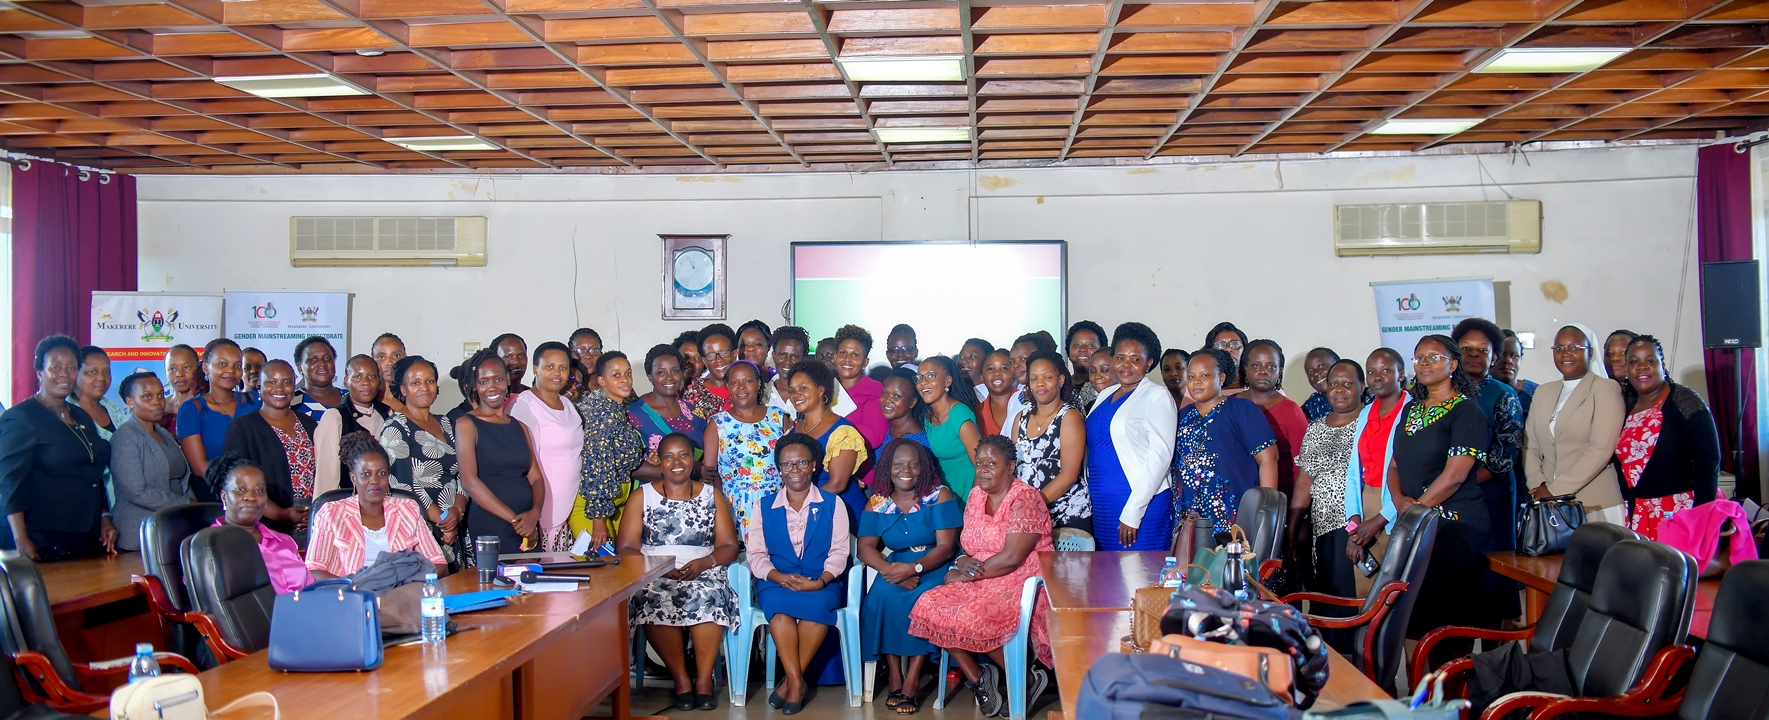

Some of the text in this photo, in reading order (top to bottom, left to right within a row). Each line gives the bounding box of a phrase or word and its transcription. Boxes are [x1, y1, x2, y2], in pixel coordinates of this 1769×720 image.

[96, 322, 218, 330] MAKERERE UNIVERSITY
[1404, 324, 1451, 332] MAINSTREAMING
